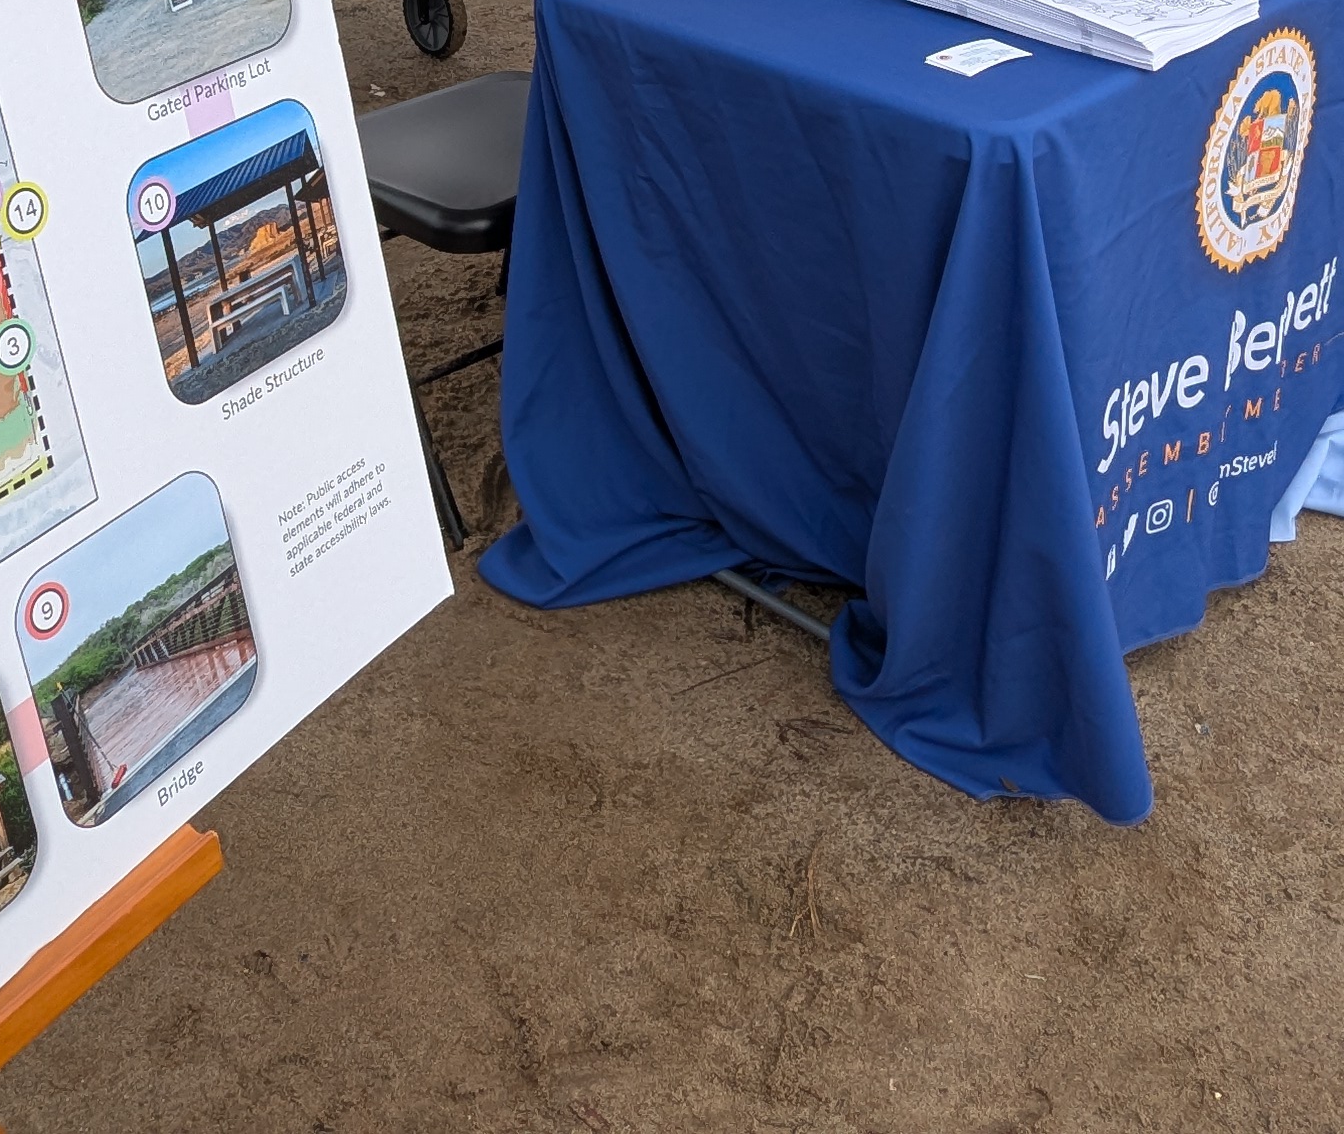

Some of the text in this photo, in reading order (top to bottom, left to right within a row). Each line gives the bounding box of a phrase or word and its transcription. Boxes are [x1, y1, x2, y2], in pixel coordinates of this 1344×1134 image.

[147, 57, 272, 122] Gated Parking Lot
[1256, 45, 1304, 76] STATE
[14, 199, 38, 222] 14
[144, 193, 165, 213] 10
[221, 347, 326, 421] Shade Structure
[1098, 354, 1209, 475] Steve
[278, 457, 366, 526] Note: Public access
[283, 471, 374, 543] elements will adhere
[286, 480, 383, 560] applicable federal and
[290, 554, 313, 577] state
[157, 758, 204, 807] Bridge
